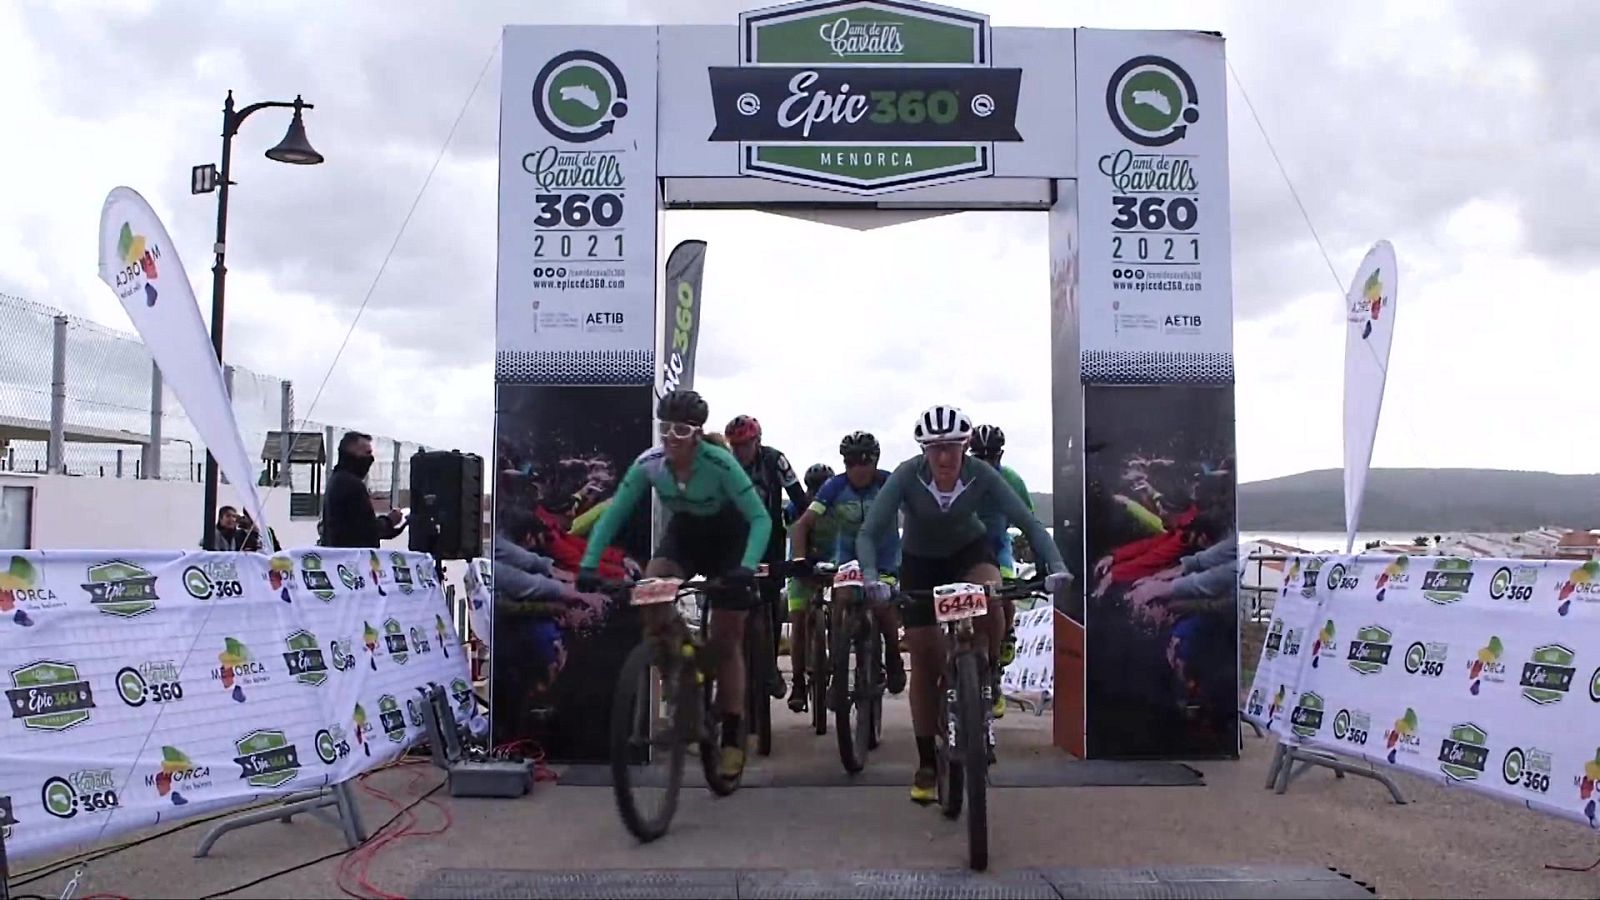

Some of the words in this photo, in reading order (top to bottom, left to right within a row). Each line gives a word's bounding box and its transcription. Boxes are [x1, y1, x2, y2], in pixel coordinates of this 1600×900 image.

[831, 26, 905, 56] Cavalls
[777, 71, 868, 137] Epic
[821, 153, 913, 166] MENORCA
[536, 155, 626, 192] Cavalls
[1112, 160, 1199, 194] Cavalls
[534, 234, 623, 257] 2021
[1113, 237, 1199, 260] 2021
[533, 278, 625, 291] www.epiccdc360.com
[586, 312, 624, 324] AETIB
[672, 281, 694, 355] 360
[1164, 315, 1201, 327] AETIB
[215, 581, 242, 597] 360
[1340, 577, 1358, 589] 360
[1507, 586, 1532, 600] 360
[939, 595, 984, 614] 644A
[1421, 661, 1443, 676] 360
[28, 689, 53, 713] Epic
[149, 682, 182, 702] 360
[1348, 728, 1367, 745] 360
[1523, 771, 1549, 793] 360
[80, 790, 118, 811] 360
